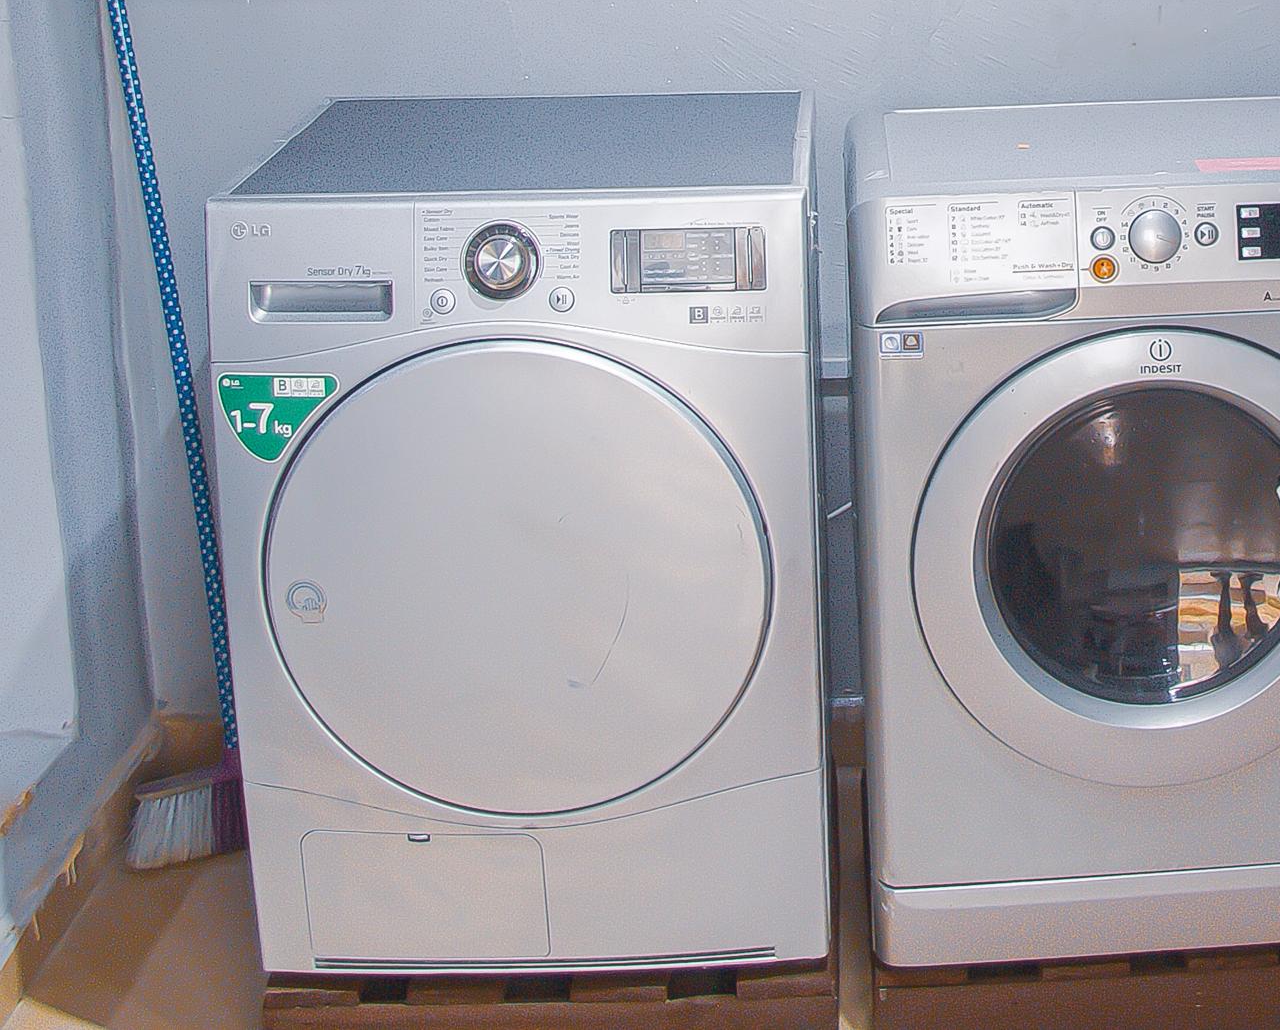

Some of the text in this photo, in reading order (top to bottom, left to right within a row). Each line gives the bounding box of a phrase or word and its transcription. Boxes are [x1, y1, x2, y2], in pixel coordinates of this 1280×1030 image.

[888, 208, 914, 216] Special
[950, 205, 981, 213] Standard
[307, 266, 335, 276] Sensor
[338, 266, 353, 278] Dry
[1263, 291, 1272, 302] A
[1140, 364, 1182, 374] INDESIT
[278, 379, 287, 392] B
